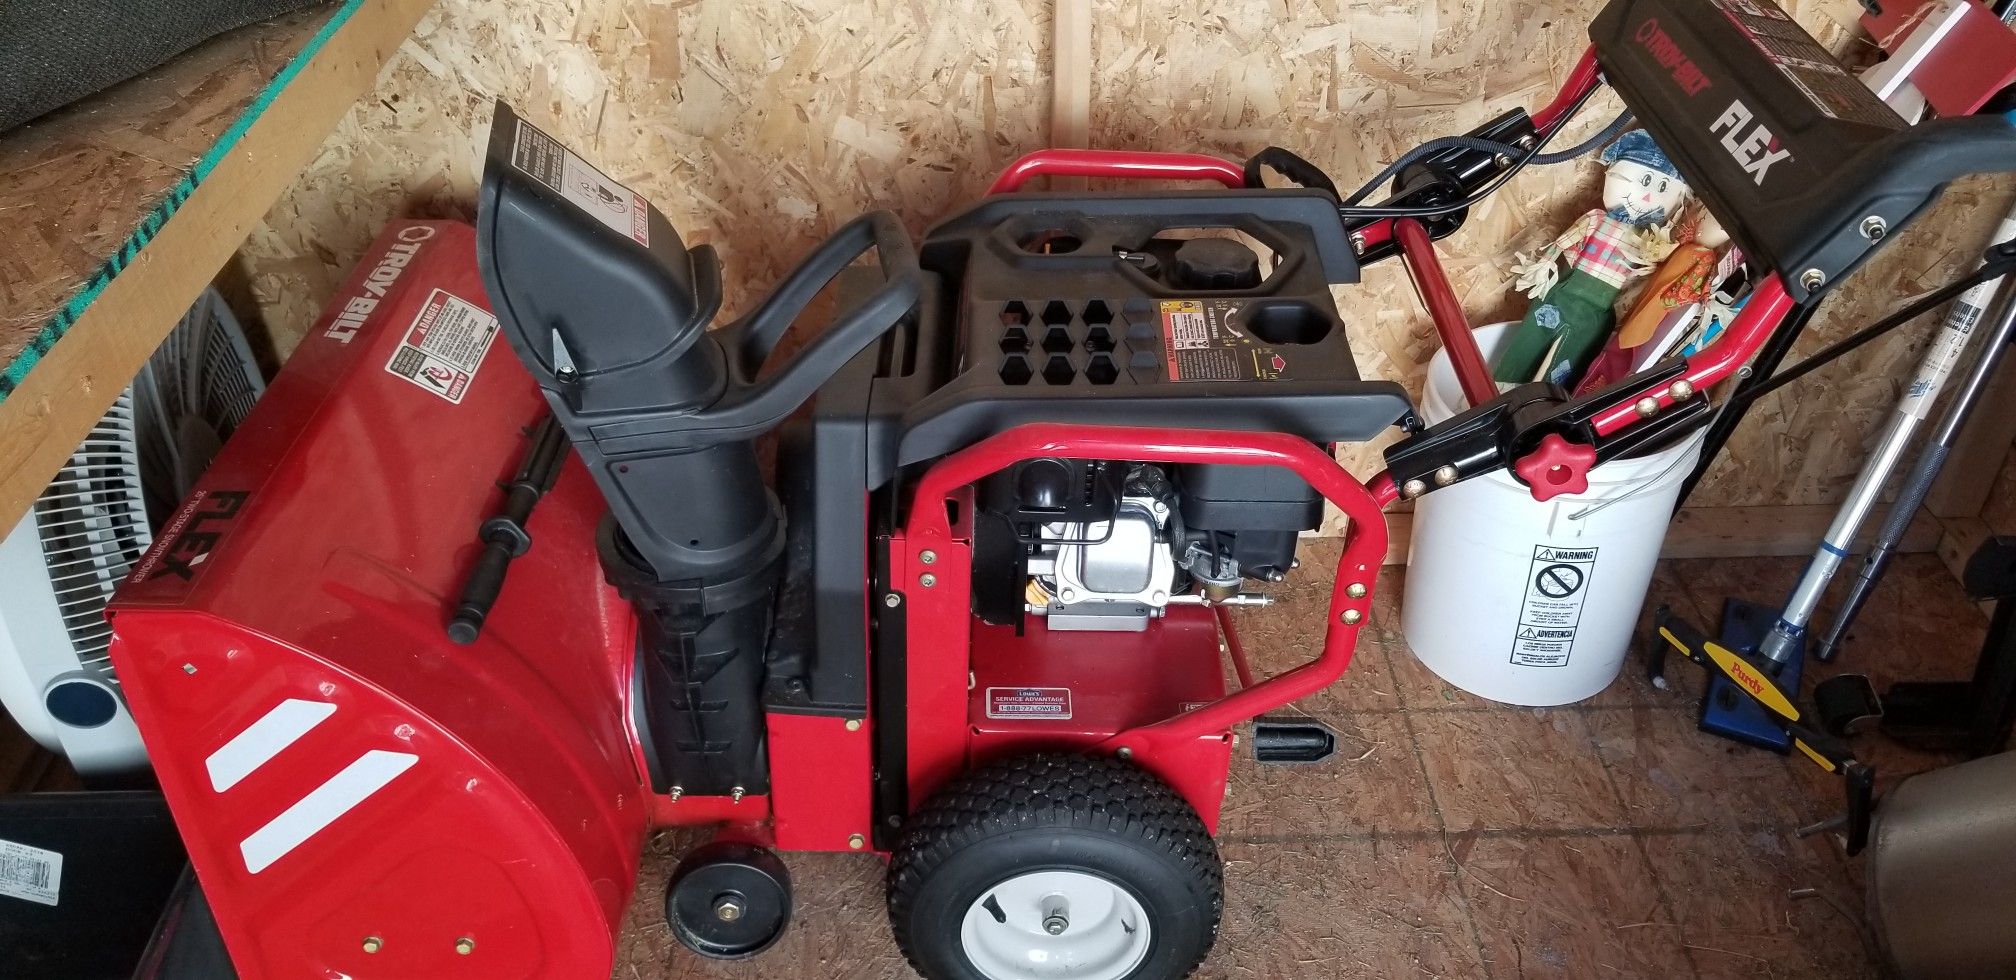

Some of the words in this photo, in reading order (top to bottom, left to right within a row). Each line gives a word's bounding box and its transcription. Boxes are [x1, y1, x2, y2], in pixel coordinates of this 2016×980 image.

[1645, 26, 1712, 97] TROY-BILT
[1709, 99, 1790, 187] FLEX
[323, 243, 422, 344] TROY-BILT
[422, 303, 442, 331] DANGER
[168, 499, 200, 534] TWO-STAGE
[148, 490, 251, 583] FLEX
[131, 534, 175, 583] SNOWTHROWER
[1555, 550, 1594, 560] WARNING
[1537, 629, 1573, 639] ADVERTENCIA
[1731, 661, 1765, 695] Purdy
[1000, 704, 1060, 712] 1-888-77LOWES
